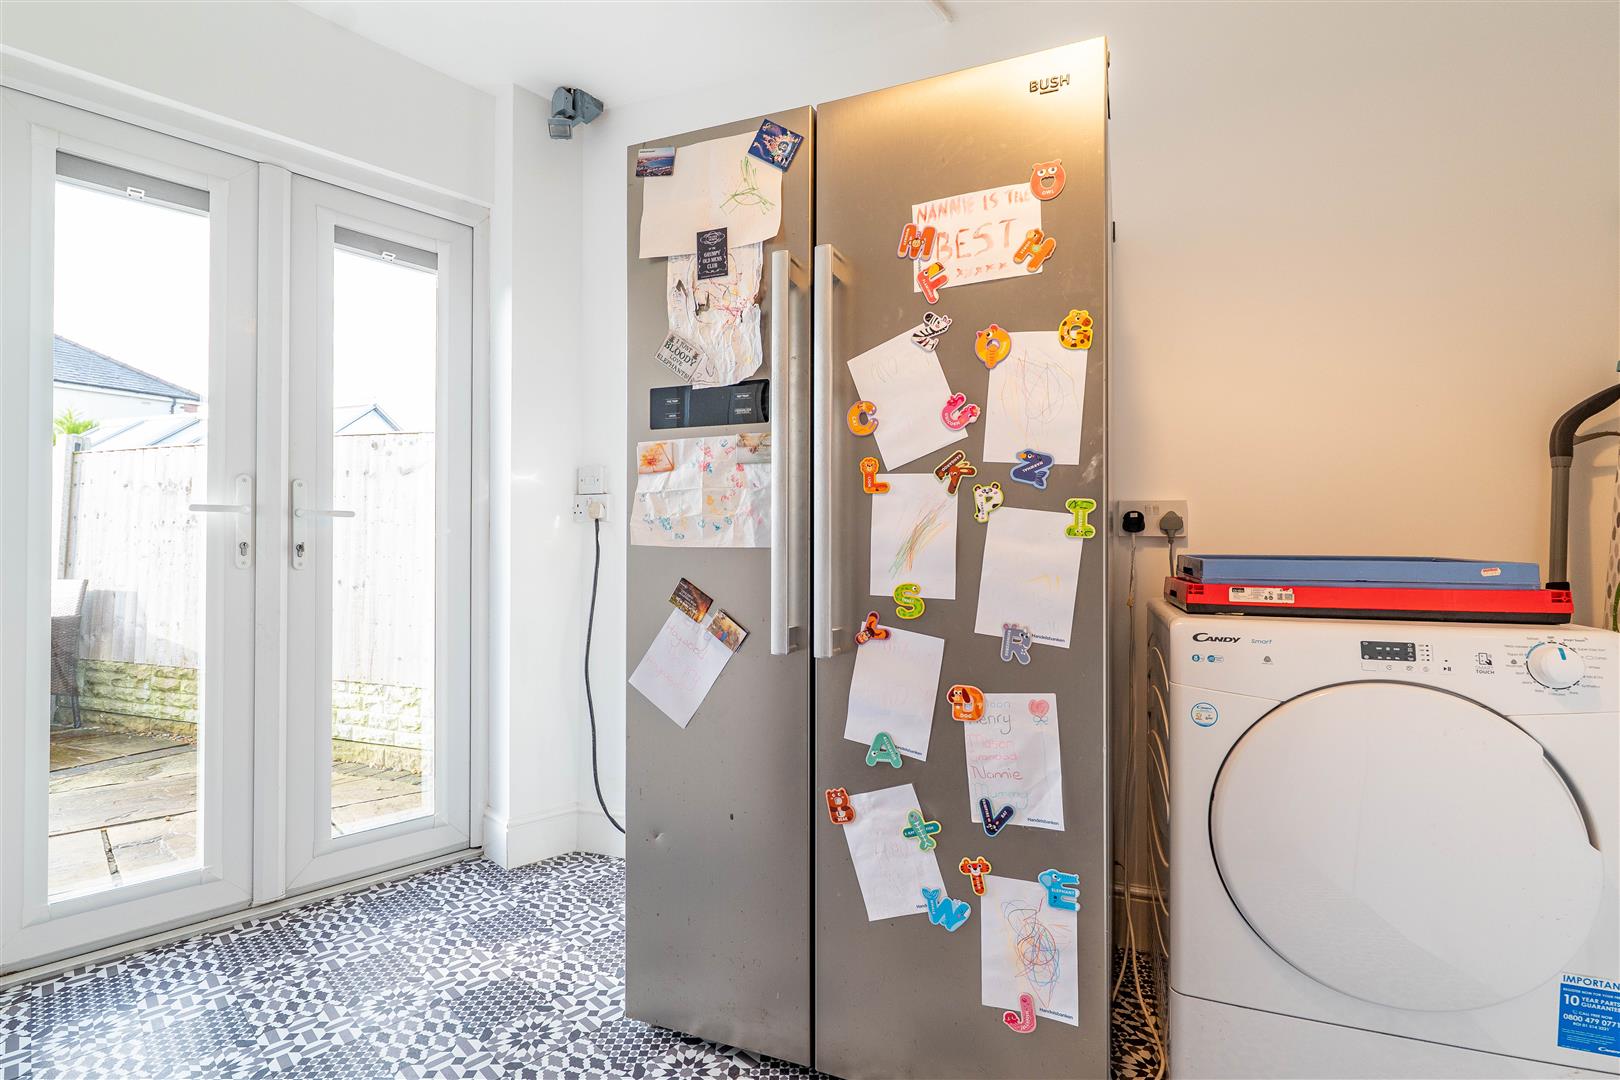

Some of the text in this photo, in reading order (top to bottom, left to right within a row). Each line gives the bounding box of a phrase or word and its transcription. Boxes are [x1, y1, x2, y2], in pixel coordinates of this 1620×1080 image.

[1029, 73, 1071, 93] BUSH
[917, 197, 975, 223] NANNIE
[983, 192, 998, 210] IS
[937, 218, 1017, 262] BEST
[664, 340, 697, 367] BLOODY
[680, 341, 694, 353] JUST
[670, 354, 684, 366] LOVE
[970, 765, 1023, 780] Nannie
[1051, 887, 1075, 896] ELEPHANT
[1564, 993, 1580, 1007] 10
[1582, 996, 1599, 1004] YEAR
[1563, 1013, 1620, 1029] 0800 479 0771
